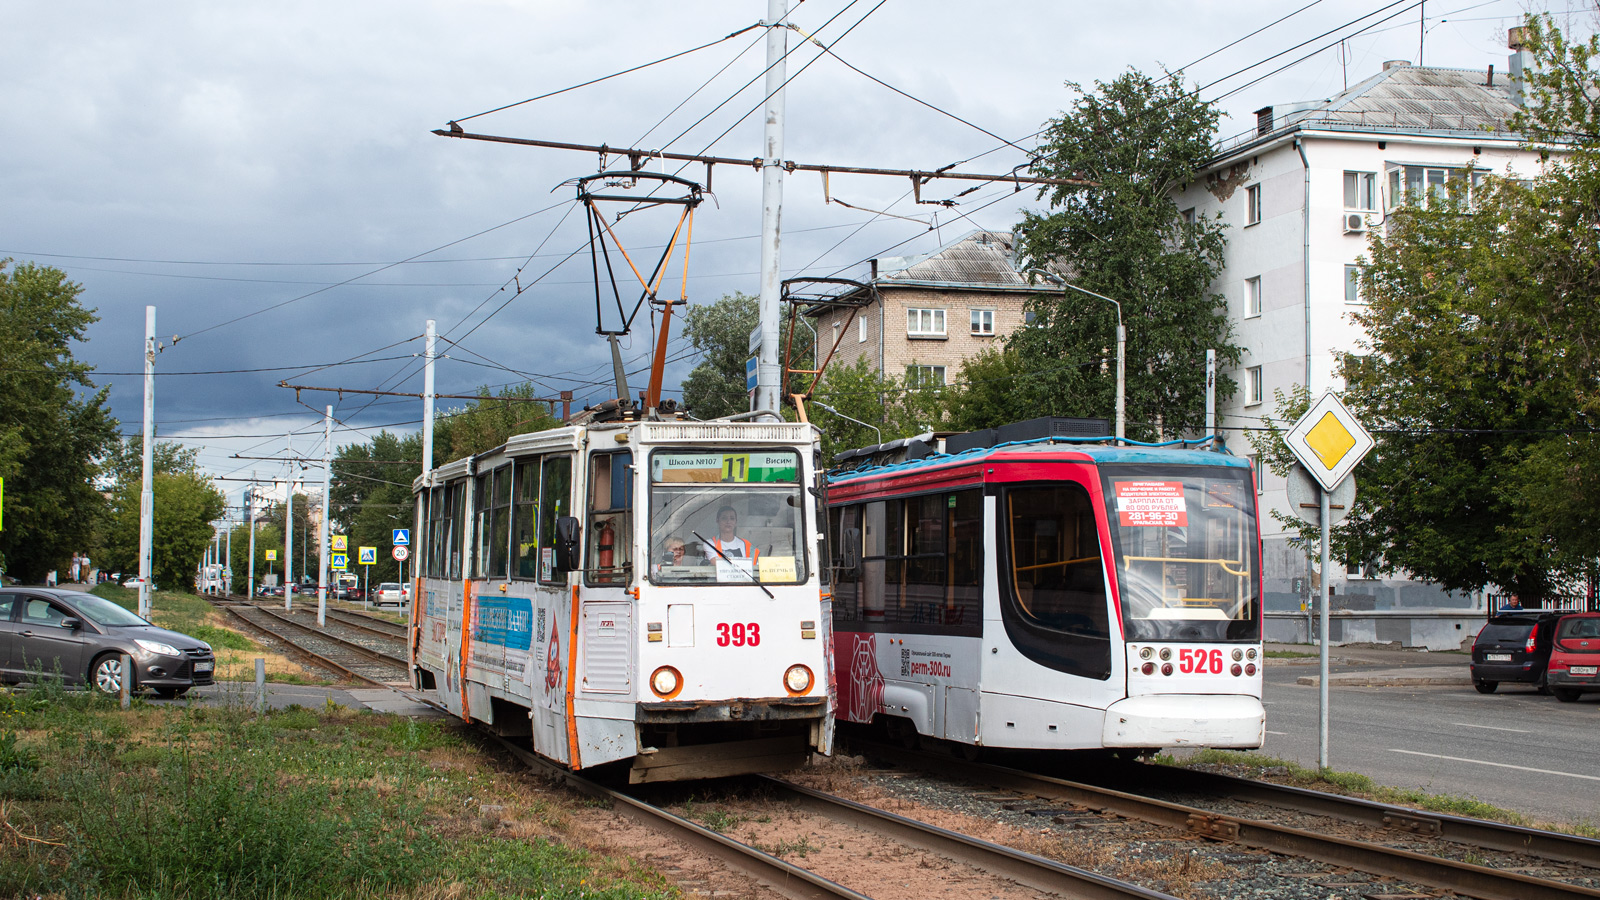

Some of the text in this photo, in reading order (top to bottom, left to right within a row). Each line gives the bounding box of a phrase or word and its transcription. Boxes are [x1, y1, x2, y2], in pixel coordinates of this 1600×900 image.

[668, 458, 694, 466] Школа
[724, 456, 745, 480] 11
[765, 457, 792, 465] Висим
[1128, 512, 1178, 520] 281-96-30
[716, 622, 761, 647] 393
[911, 661, 951, 678] perm-300.ru
[1179, 648, 1223, 674] 526
